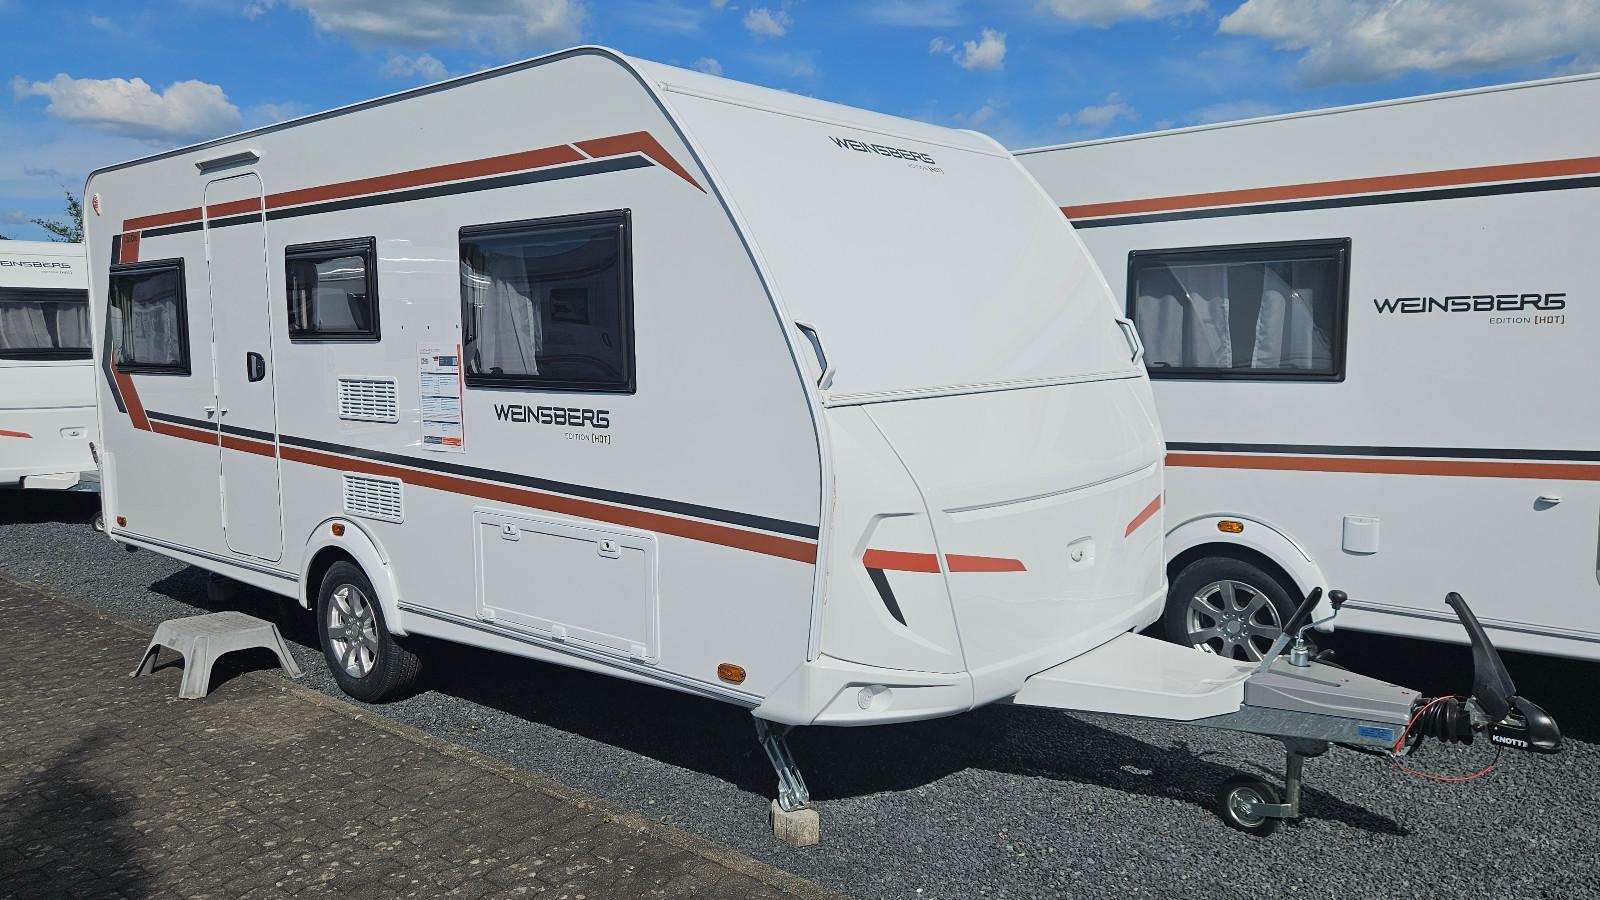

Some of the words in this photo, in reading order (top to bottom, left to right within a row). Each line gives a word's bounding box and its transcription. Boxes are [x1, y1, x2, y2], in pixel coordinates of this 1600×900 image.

[828, 135, 936, 165] WEINSBERG
[0, 260, 71, 269] EINSBERG
[1373, 292, 1567, 314] WEINSBERG
[1489, 317, 1531, 325] EDITION
[1534, 315, 1566, 325] [HOT]
[494, 403, 610, 429] WEINSBERG
[564, 432, 590, 442] EDITION
[591, 433, 611, 445] [HOT]
[1492, 734, 1524, 748] KNOTT
